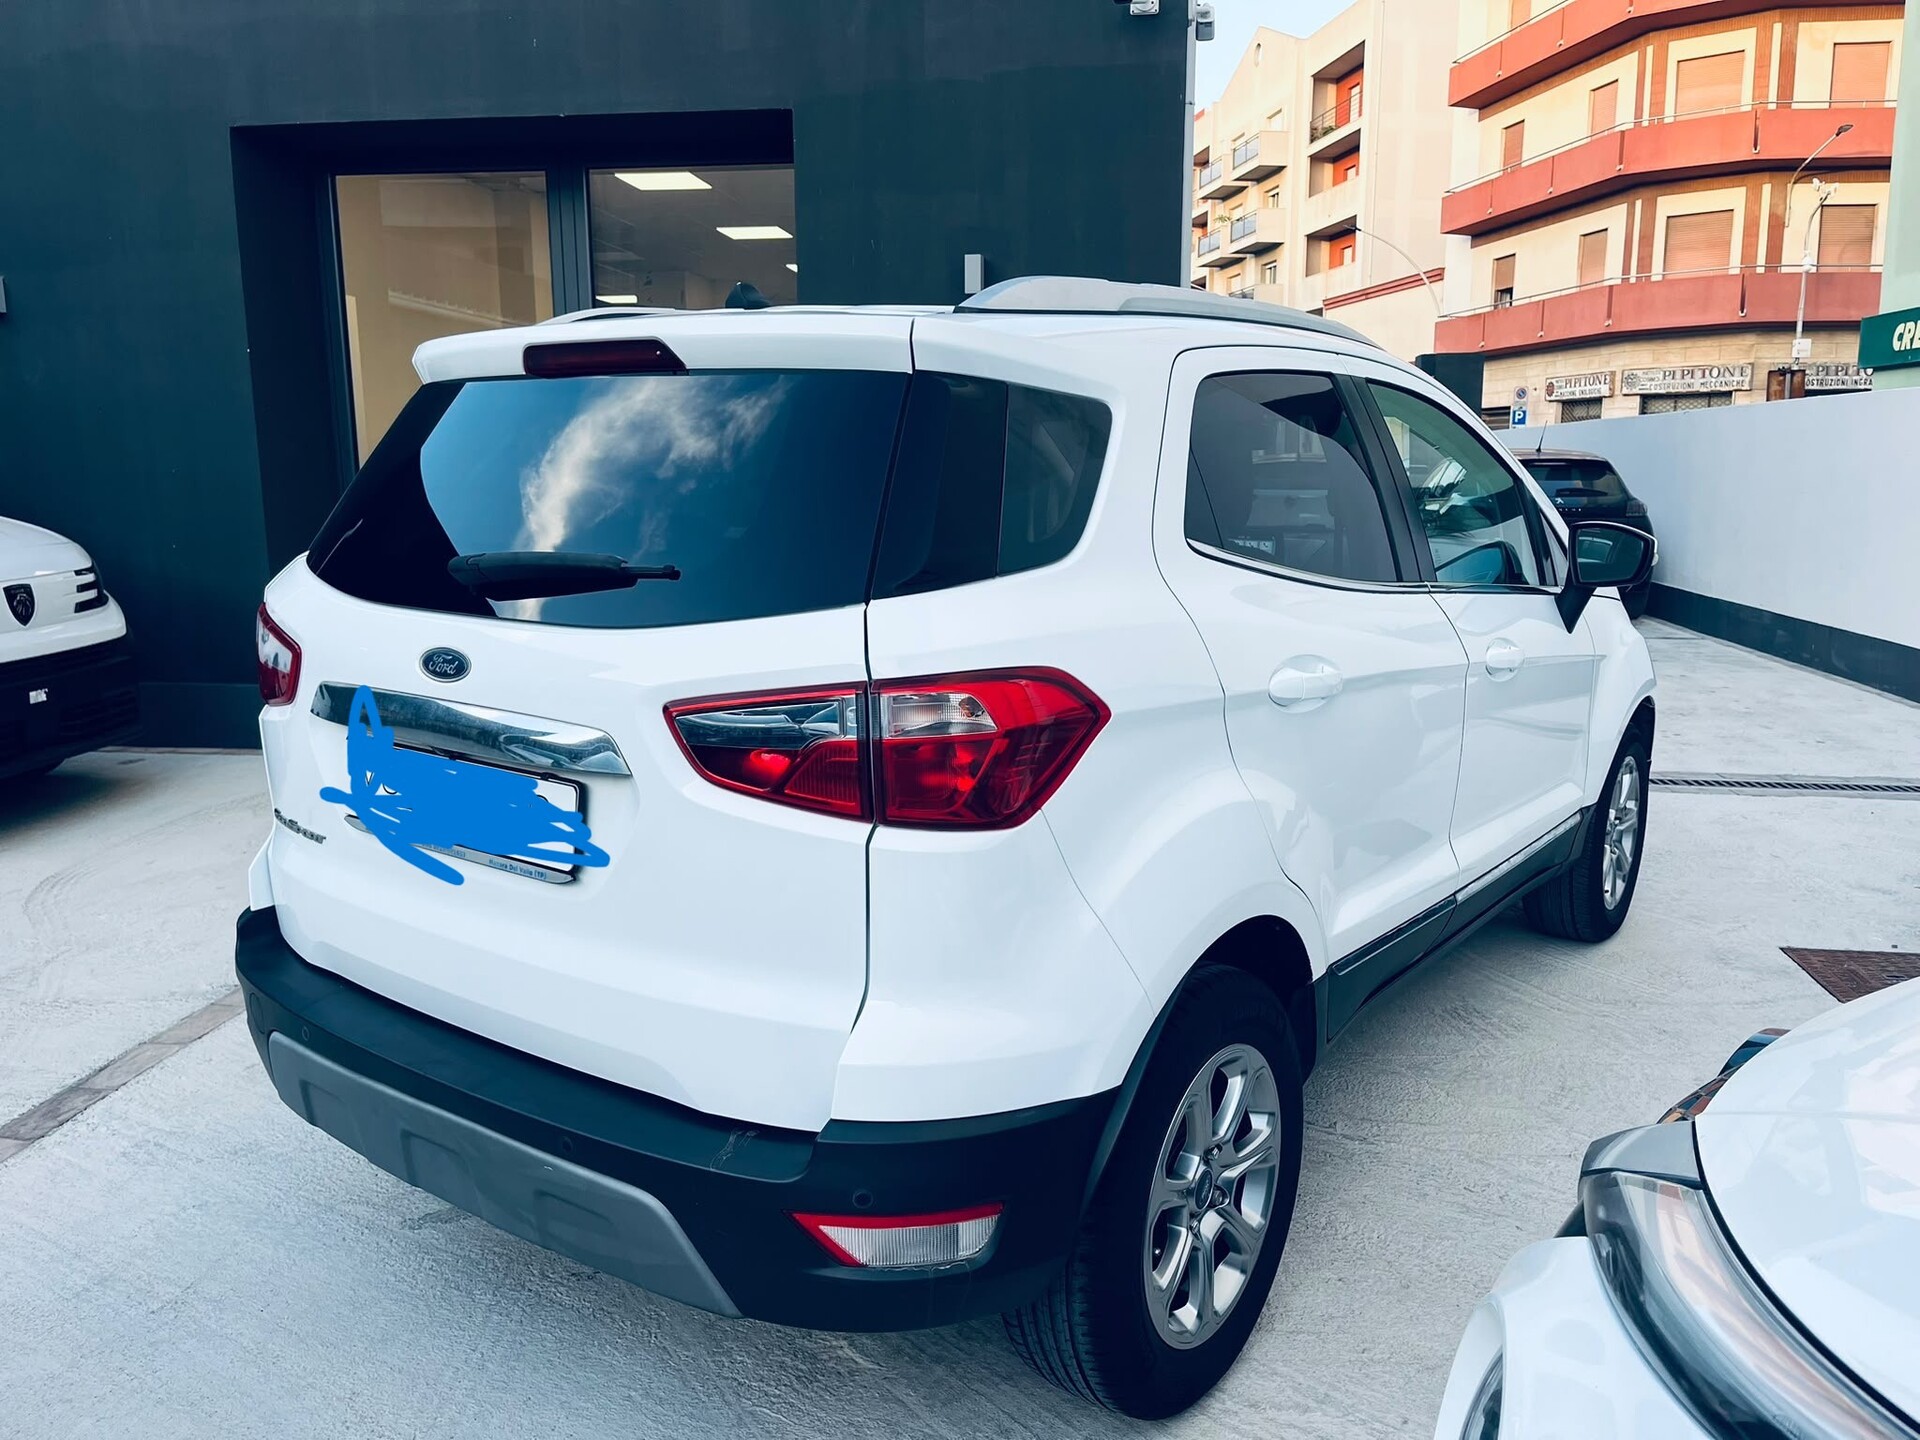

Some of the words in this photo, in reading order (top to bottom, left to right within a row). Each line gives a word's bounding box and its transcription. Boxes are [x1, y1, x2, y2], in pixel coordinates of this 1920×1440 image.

[1662, 365, 1749, 380] PIPITONE
[1564, 374, 1609, 388] PIPITONE
[1649, 381, 1695, 391] COSTRUZIONI
[1700, 379, 1745, 389] MECCANICHE
[1805, 378, 1848, 387] OSTRUZIONI
[1514, 411, 1524, 423] P
[428, 653, 459, 675] Ford
